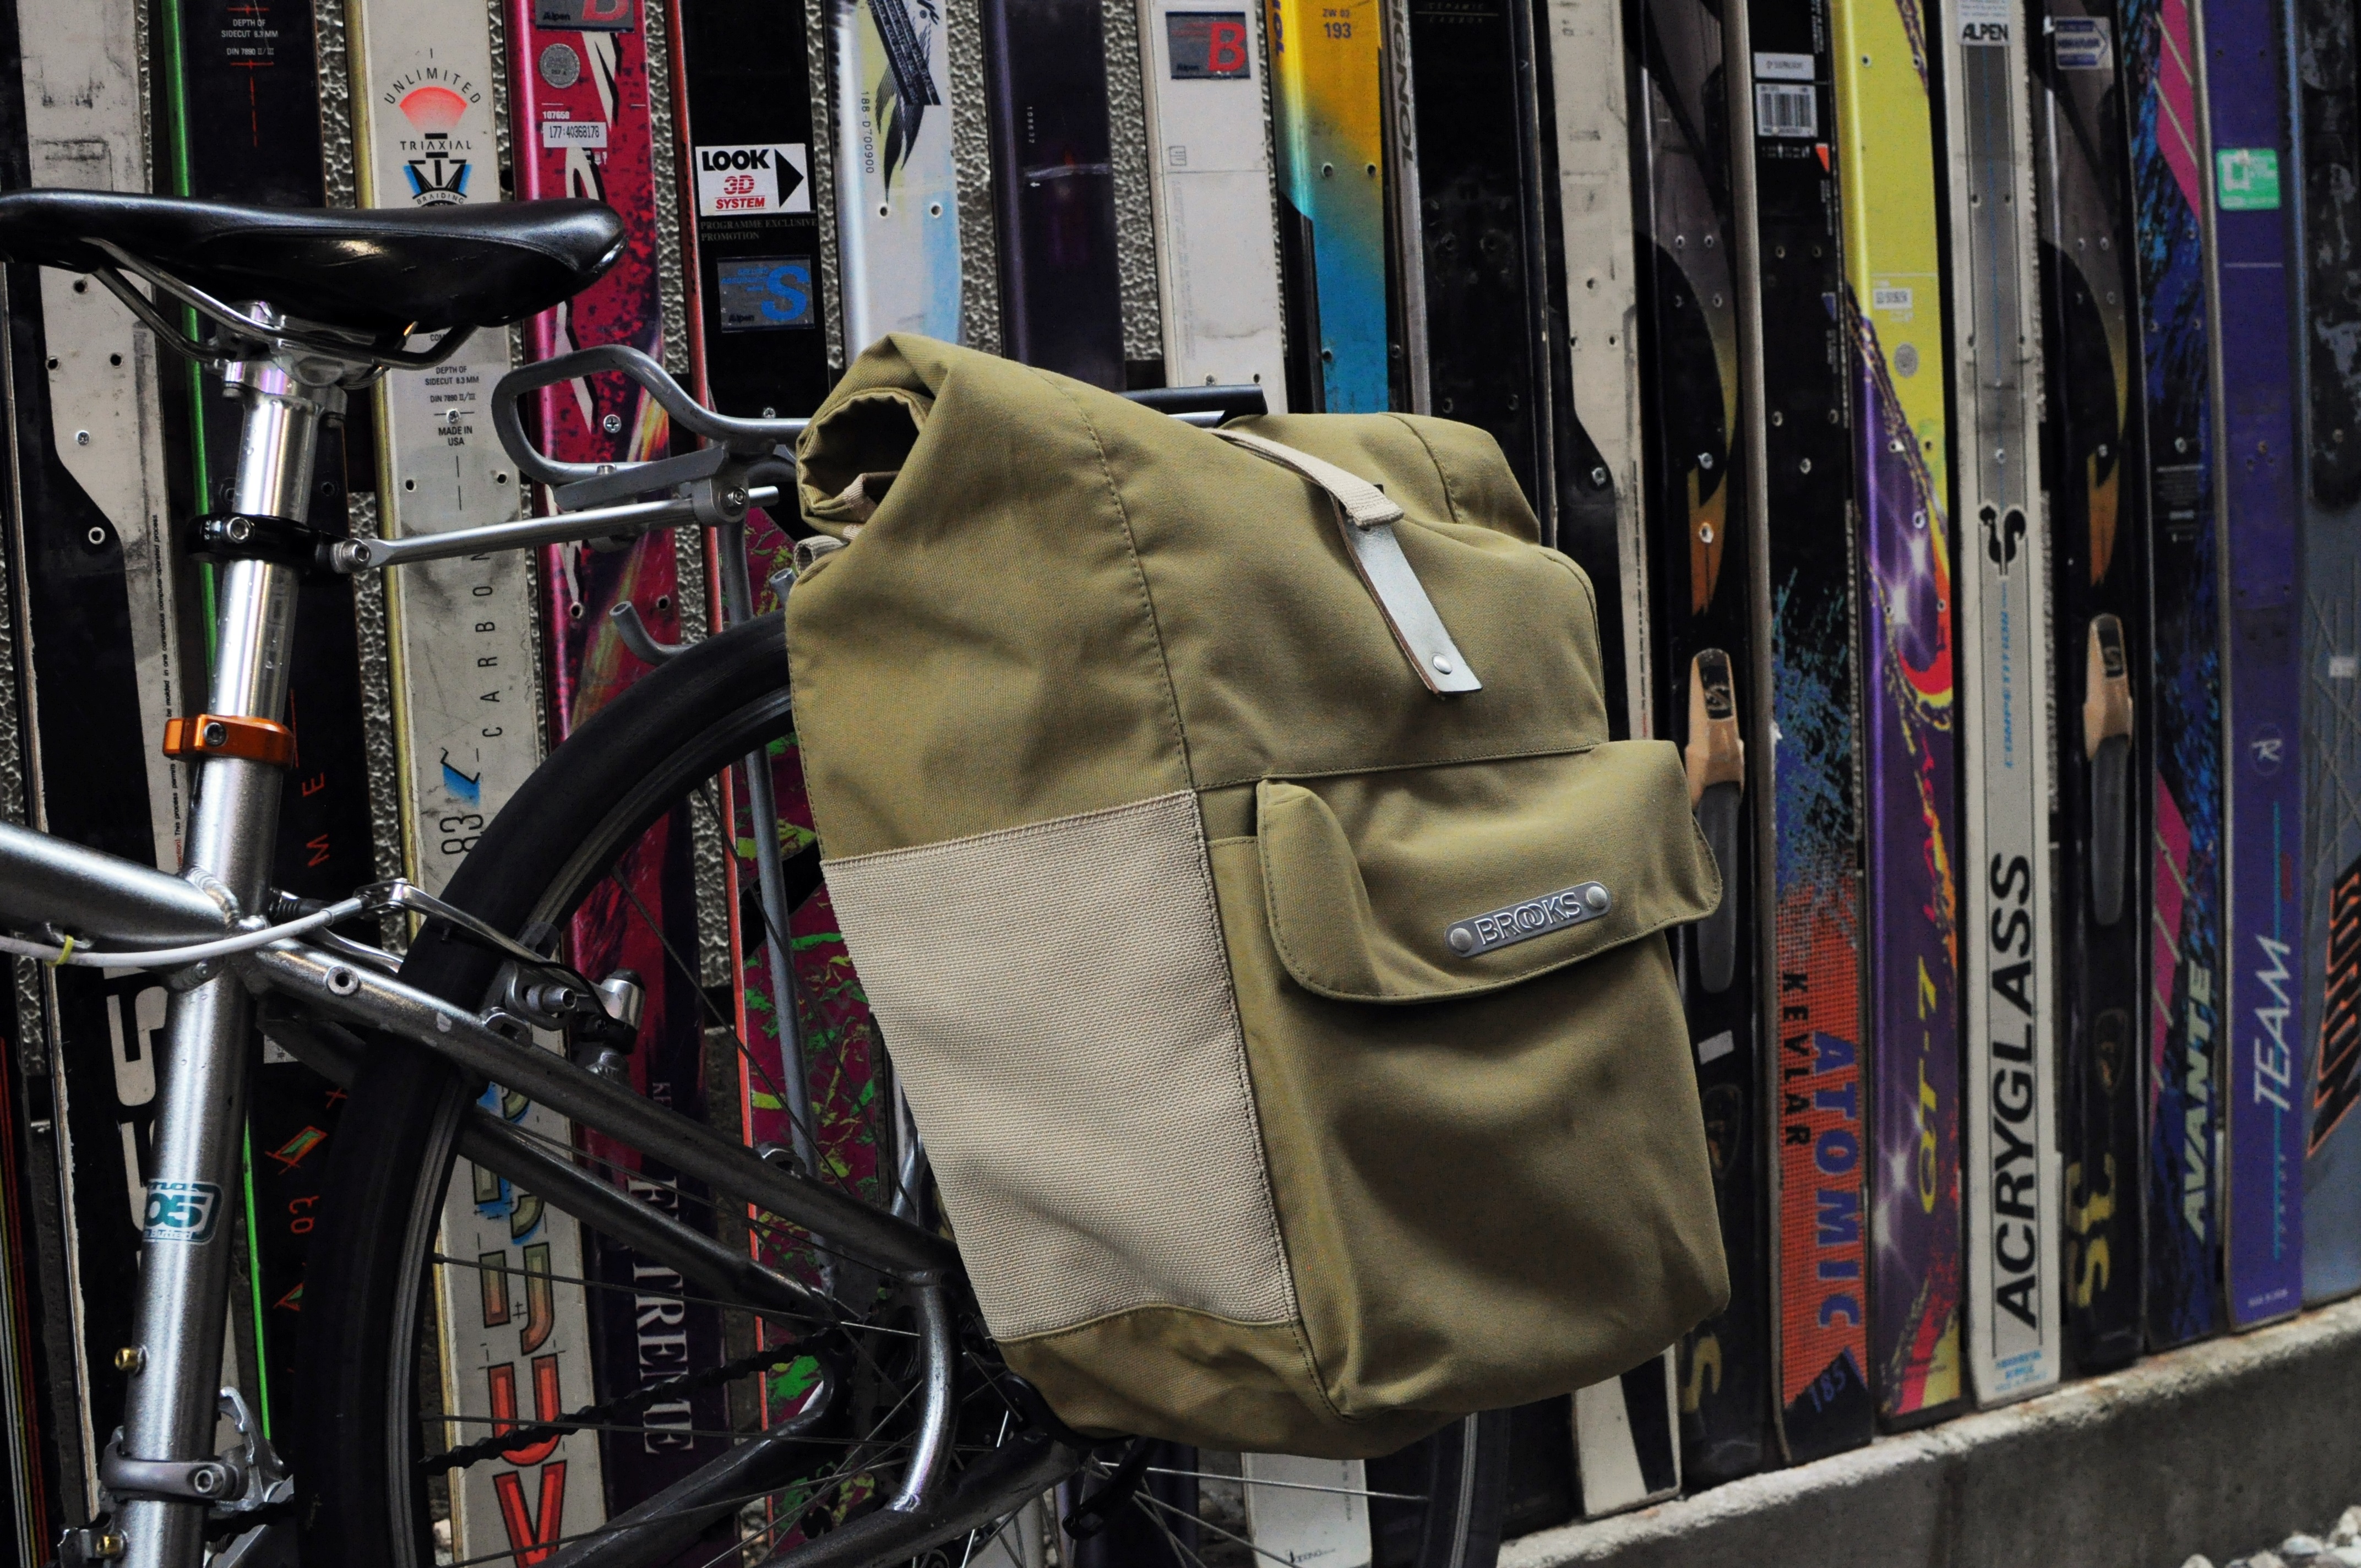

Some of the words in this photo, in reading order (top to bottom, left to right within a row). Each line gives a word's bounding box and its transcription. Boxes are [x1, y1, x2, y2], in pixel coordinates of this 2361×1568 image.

[1324, 22, 1351, 39] 193
[1962, 23, 2009, 41] ALPEN
[1207, 22, 1246, 72] B
[384, 67, 481, 104] UNLIMITED
[860, 91, 874, 174] 188-D700900
[400, 140, 472, 151] TRIAXIAL
[701, 149, 770, 171] LOOK
[723, 175, 754, 195] 3D
[416, 193, 464, 205] BRAIDING
[715, 197, 765, 209] SYSTEM
[700, 220, 763, 230] PROGRAMME
[765, 218, 817, 228] EXCLUSIVE
[701, 231, 759, 241] PROMOTION
[760, 265, 809, 321] S
[425, 378, 453, 386] SIDECUT
[438, 426, 461, 436] MADE
[448, 438, 465, 446] USA
[154, 545, 164, 611] computer-operated
[165, 709, 172, 717] be
[1475, 892, 1581, 945] BROOKS
[2254, 935, 2291, 1112] TEAM
[1782, 972, 1811, 1146] KEVLAR
[1990, 852, 2036, 1331] ACRYGLASS
[2183, 959, 2211, 1244] AVANTE
[1813, 1031, 1861, 1328] ATOMIC
